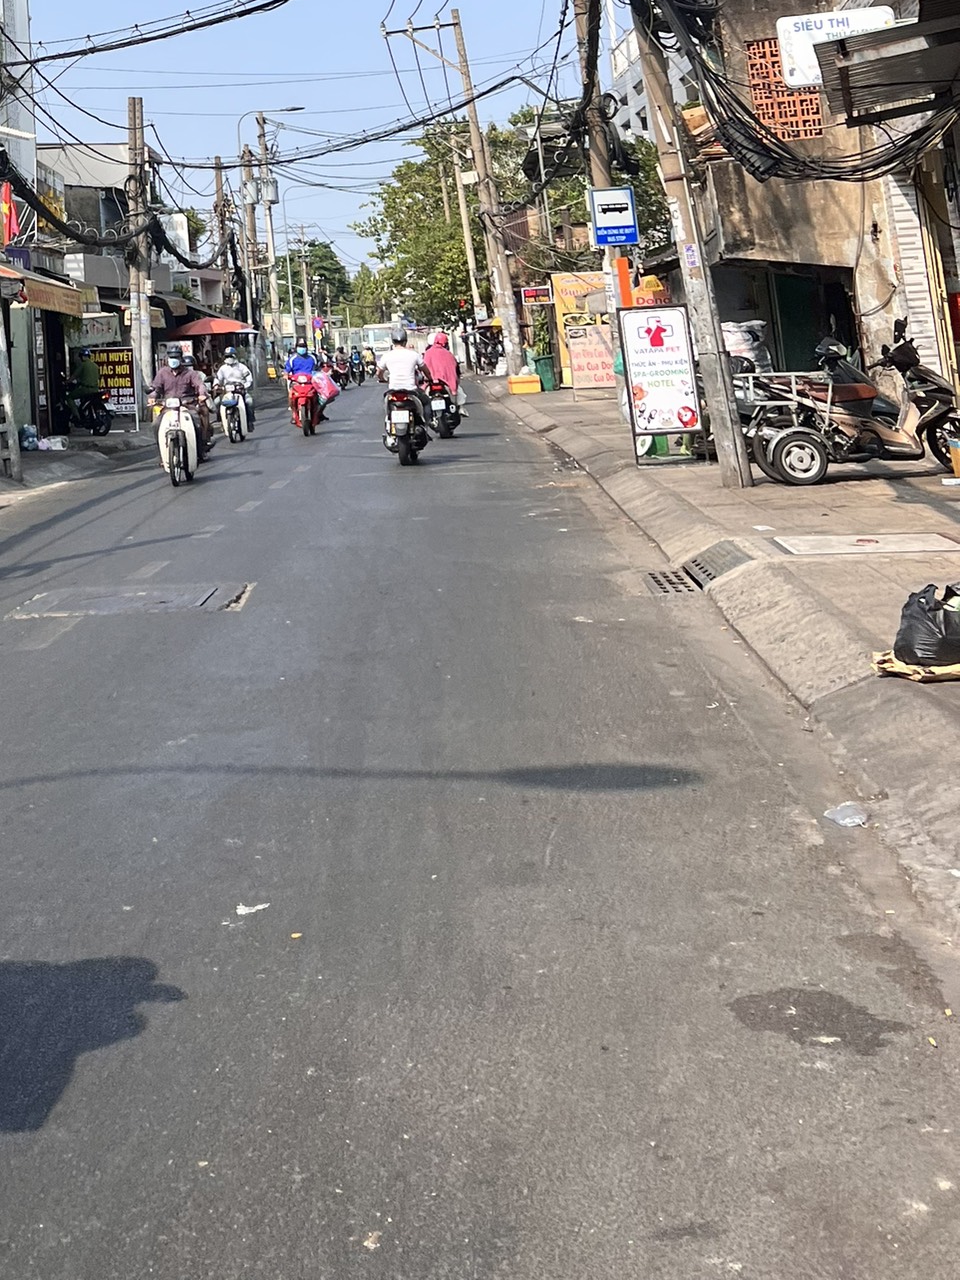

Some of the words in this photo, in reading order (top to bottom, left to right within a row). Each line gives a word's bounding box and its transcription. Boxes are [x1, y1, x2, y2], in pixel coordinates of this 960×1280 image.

[793, 17, 823, 33] SIÊU
[827, 16, 850, 29] THỊ
[109, 350, 132, 363] HUYỆT
[634, 347, 664, 355] VATAPA
[98, 363, 114, 375] IÁC
[115, 364, 130, 375] HƠI
[633, 368, 690, 379] SPA-GROOMING
[107, 375, 132, 388] NÓNG
[647, 380, 676, 388] HOTEL
